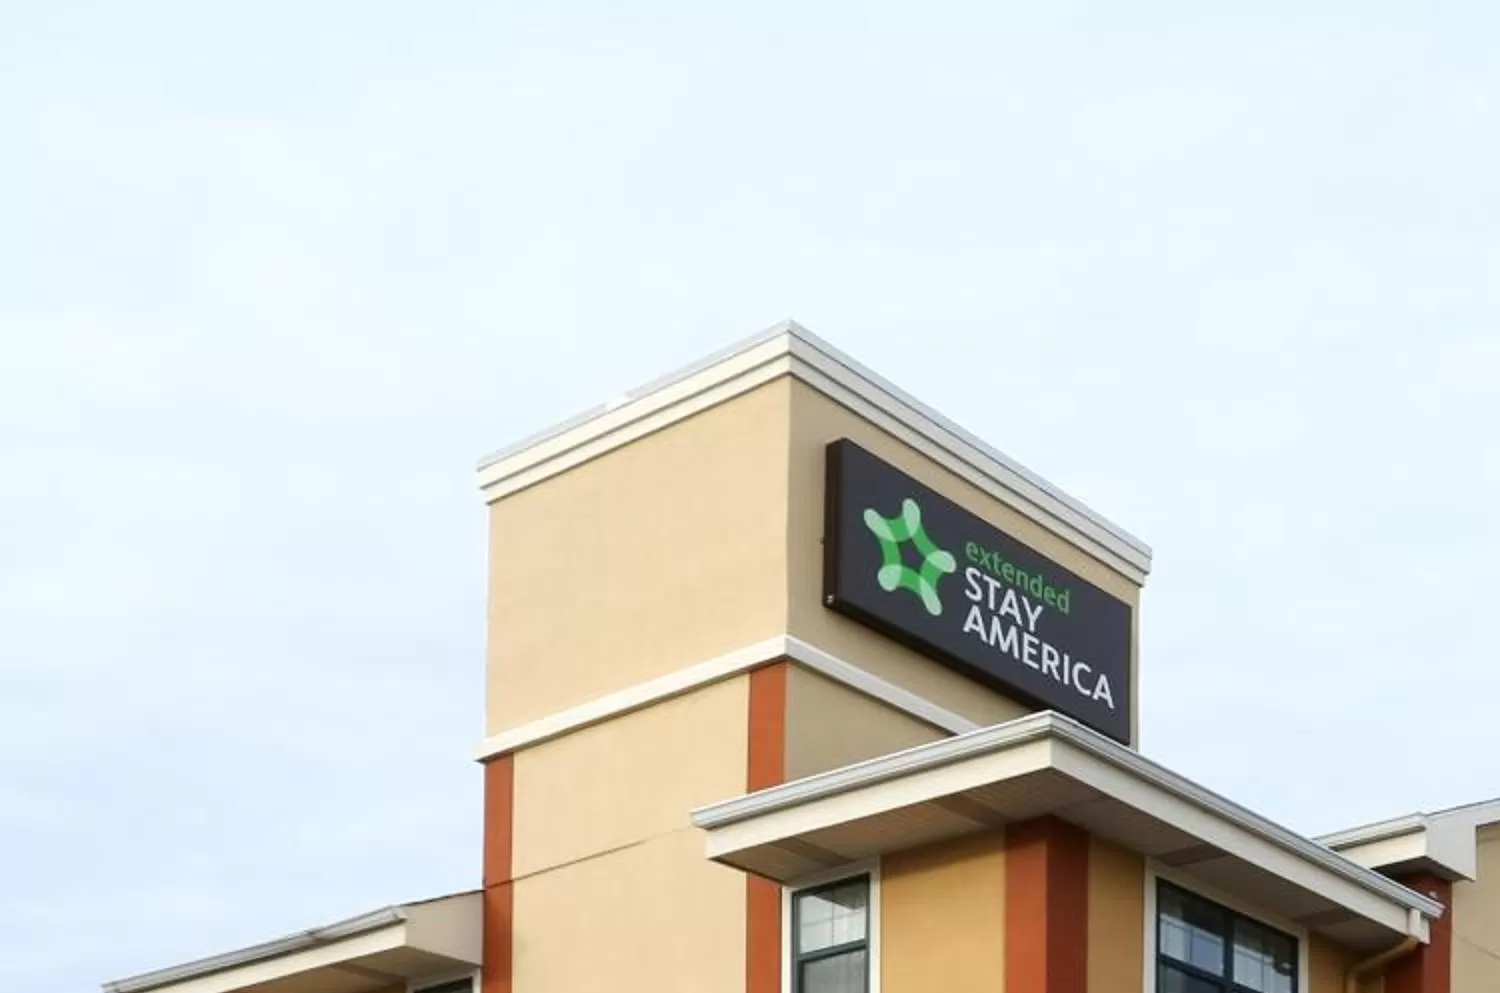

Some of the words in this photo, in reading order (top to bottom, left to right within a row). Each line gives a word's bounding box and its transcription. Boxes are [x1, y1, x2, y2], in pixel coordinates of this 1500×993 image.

[964, 567, 1044, 632] STAY
[965, 541, 1070, 615] extended
[963, 605, 1115, 709] AMERICA
